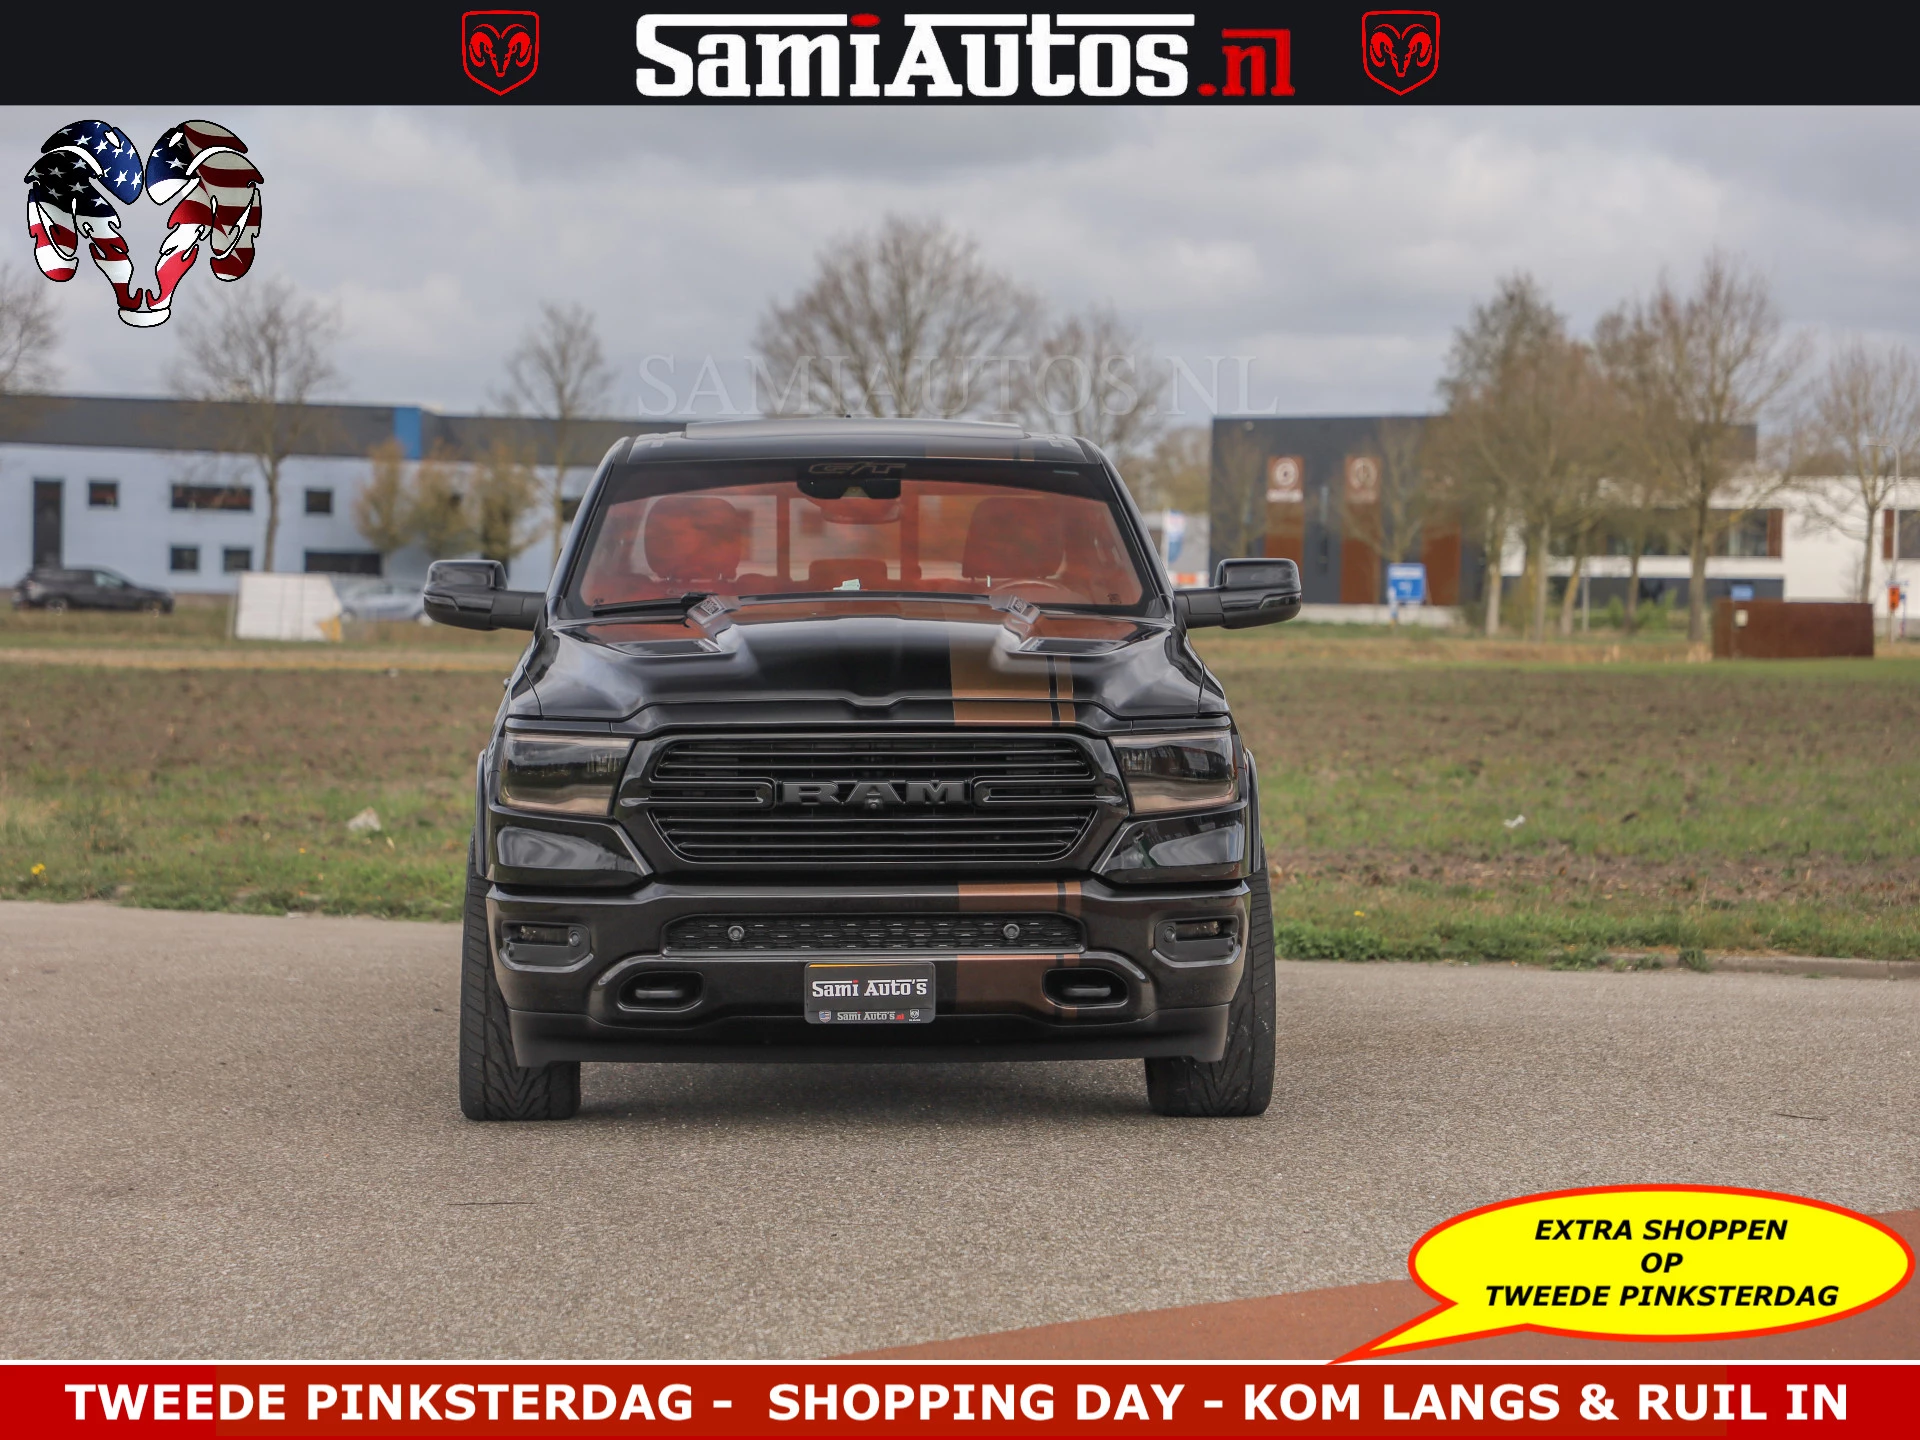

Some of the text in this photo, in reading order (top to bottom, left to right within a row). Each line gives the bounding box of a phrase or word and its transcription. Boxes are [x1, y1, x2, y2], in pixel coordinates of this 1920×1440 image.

[783, 780, 965, 804] RAM
[812, 979, 928, 997] Sami Auto's
[837, 1011, 861, 1021] Sami
